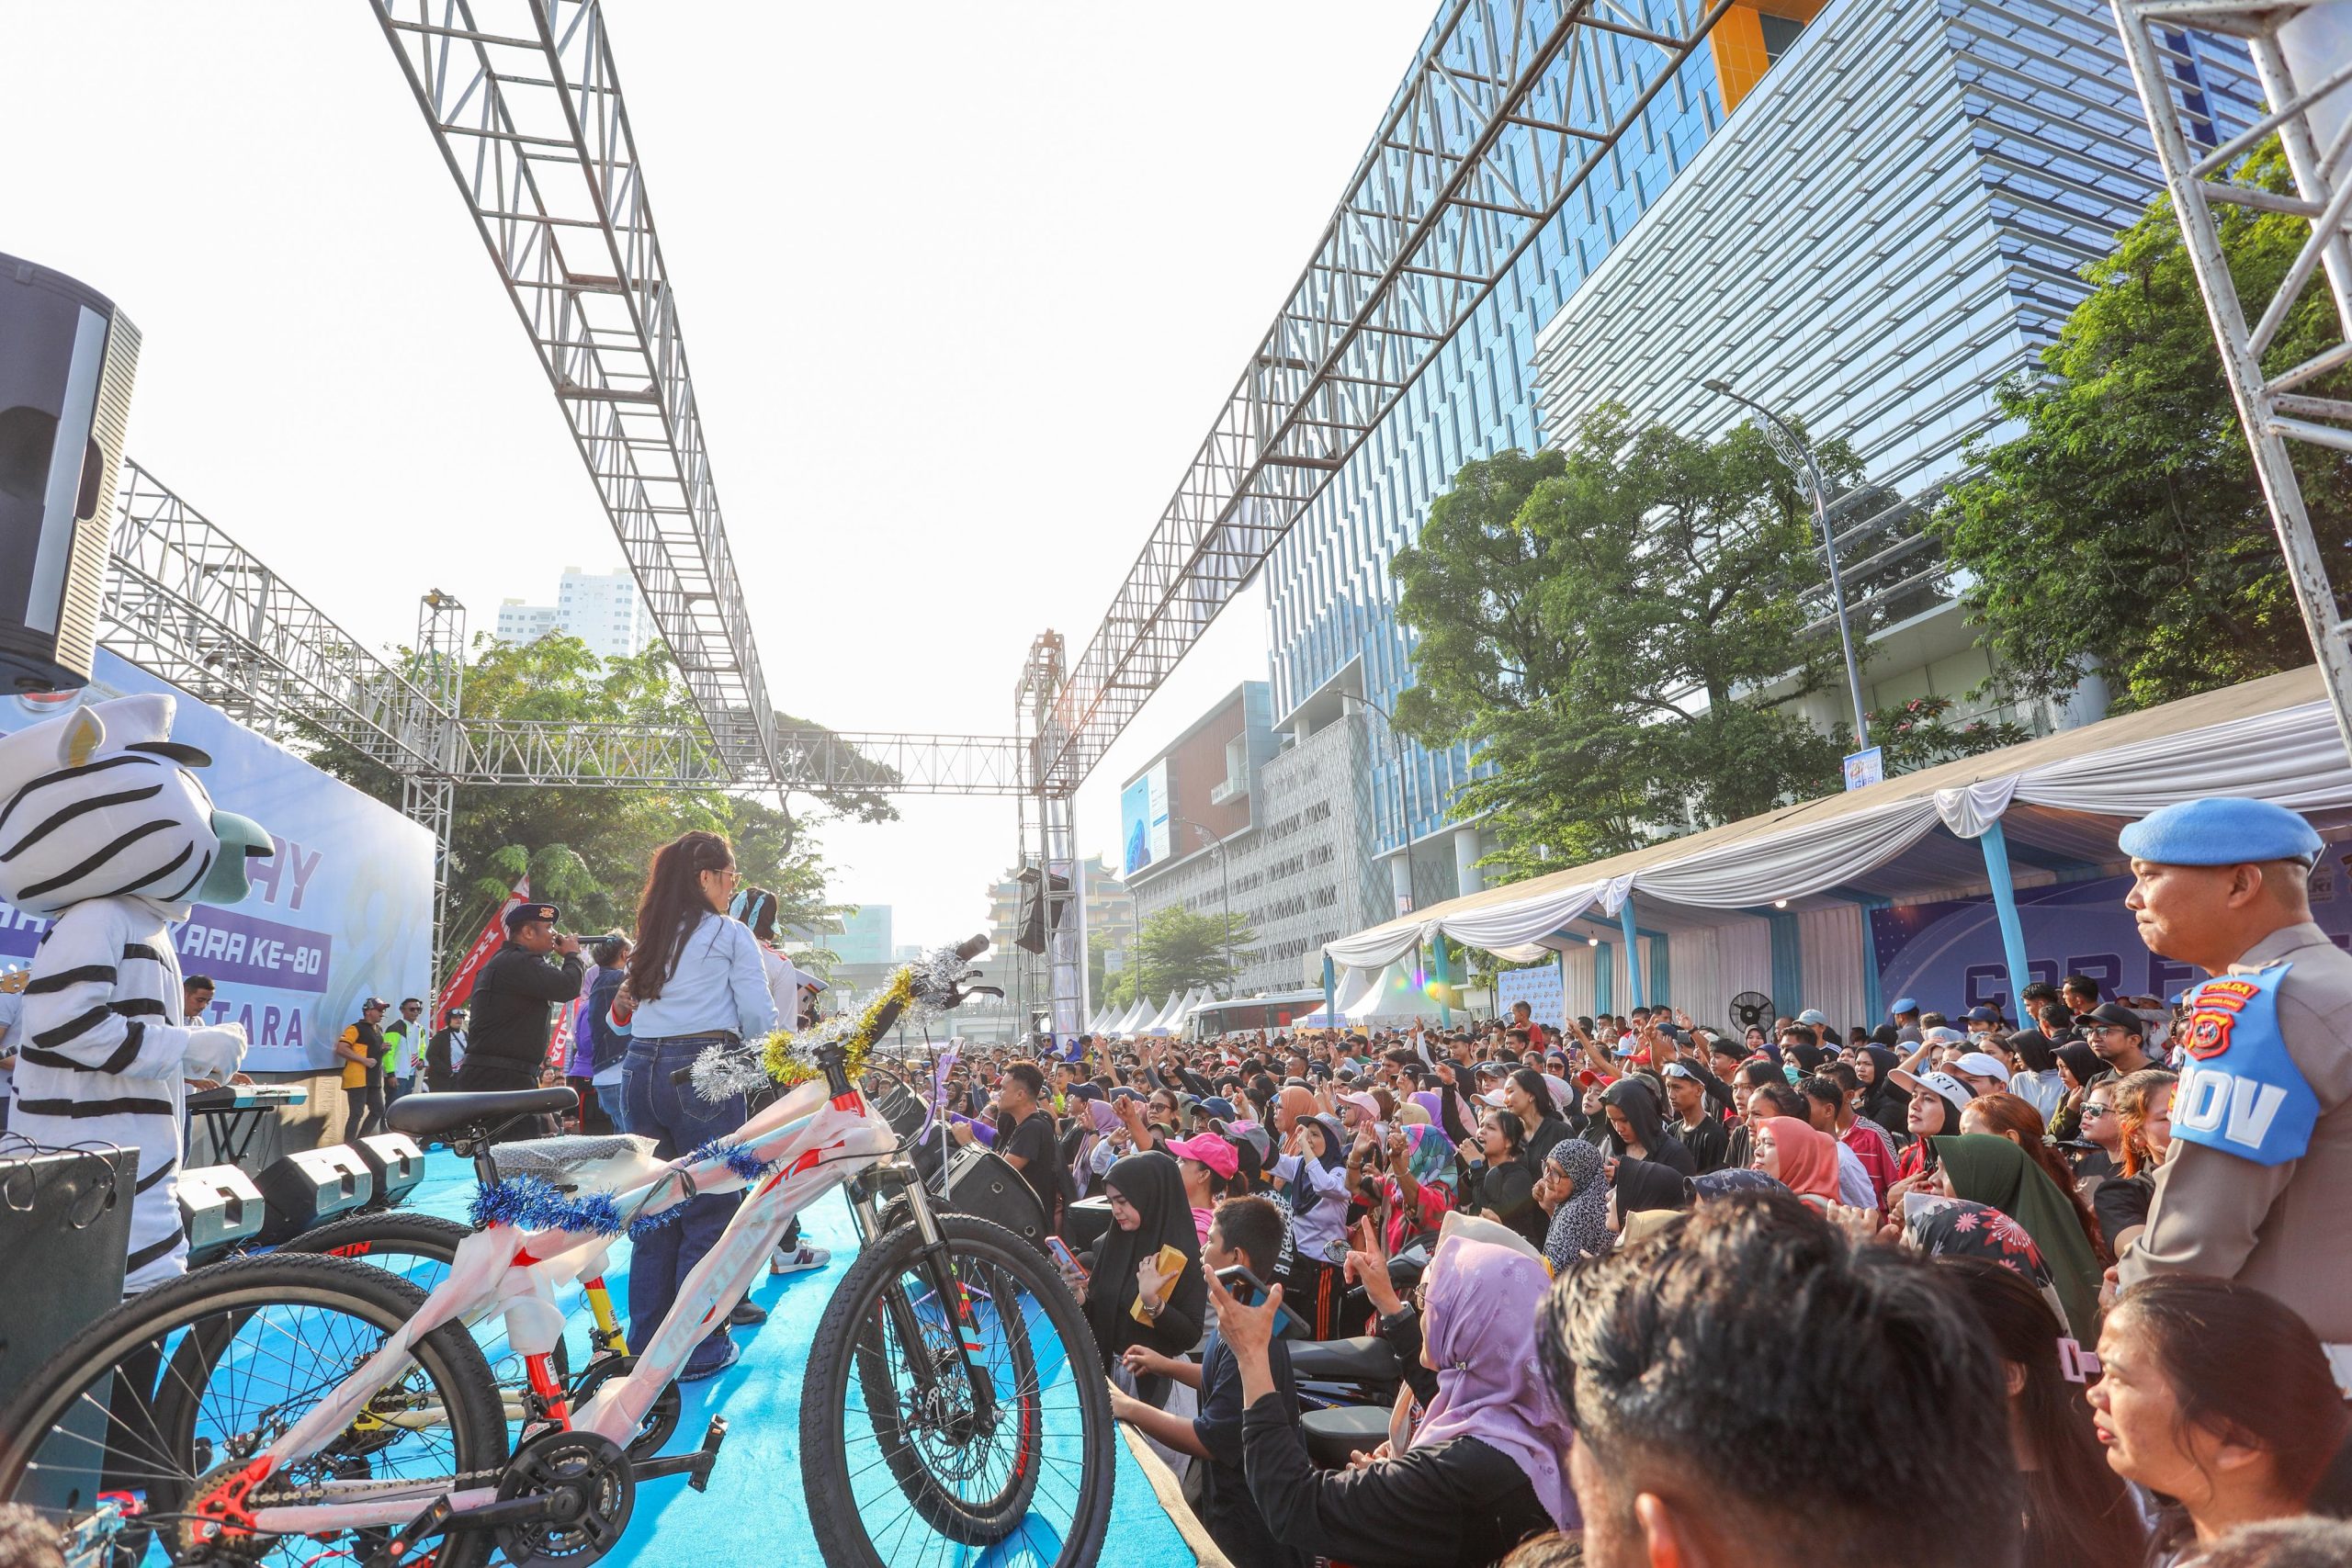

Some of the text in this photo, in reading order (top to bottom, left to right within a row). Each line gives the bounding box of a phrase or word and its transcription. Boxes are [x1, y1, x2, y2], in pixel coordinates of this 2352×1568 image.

[243, 833, 323, 911] AY
[249, 938, 322, 976] KE-80
[2206, 982, 2251, 996] POLDA
[209, 1000, 304, 1048] TARA
